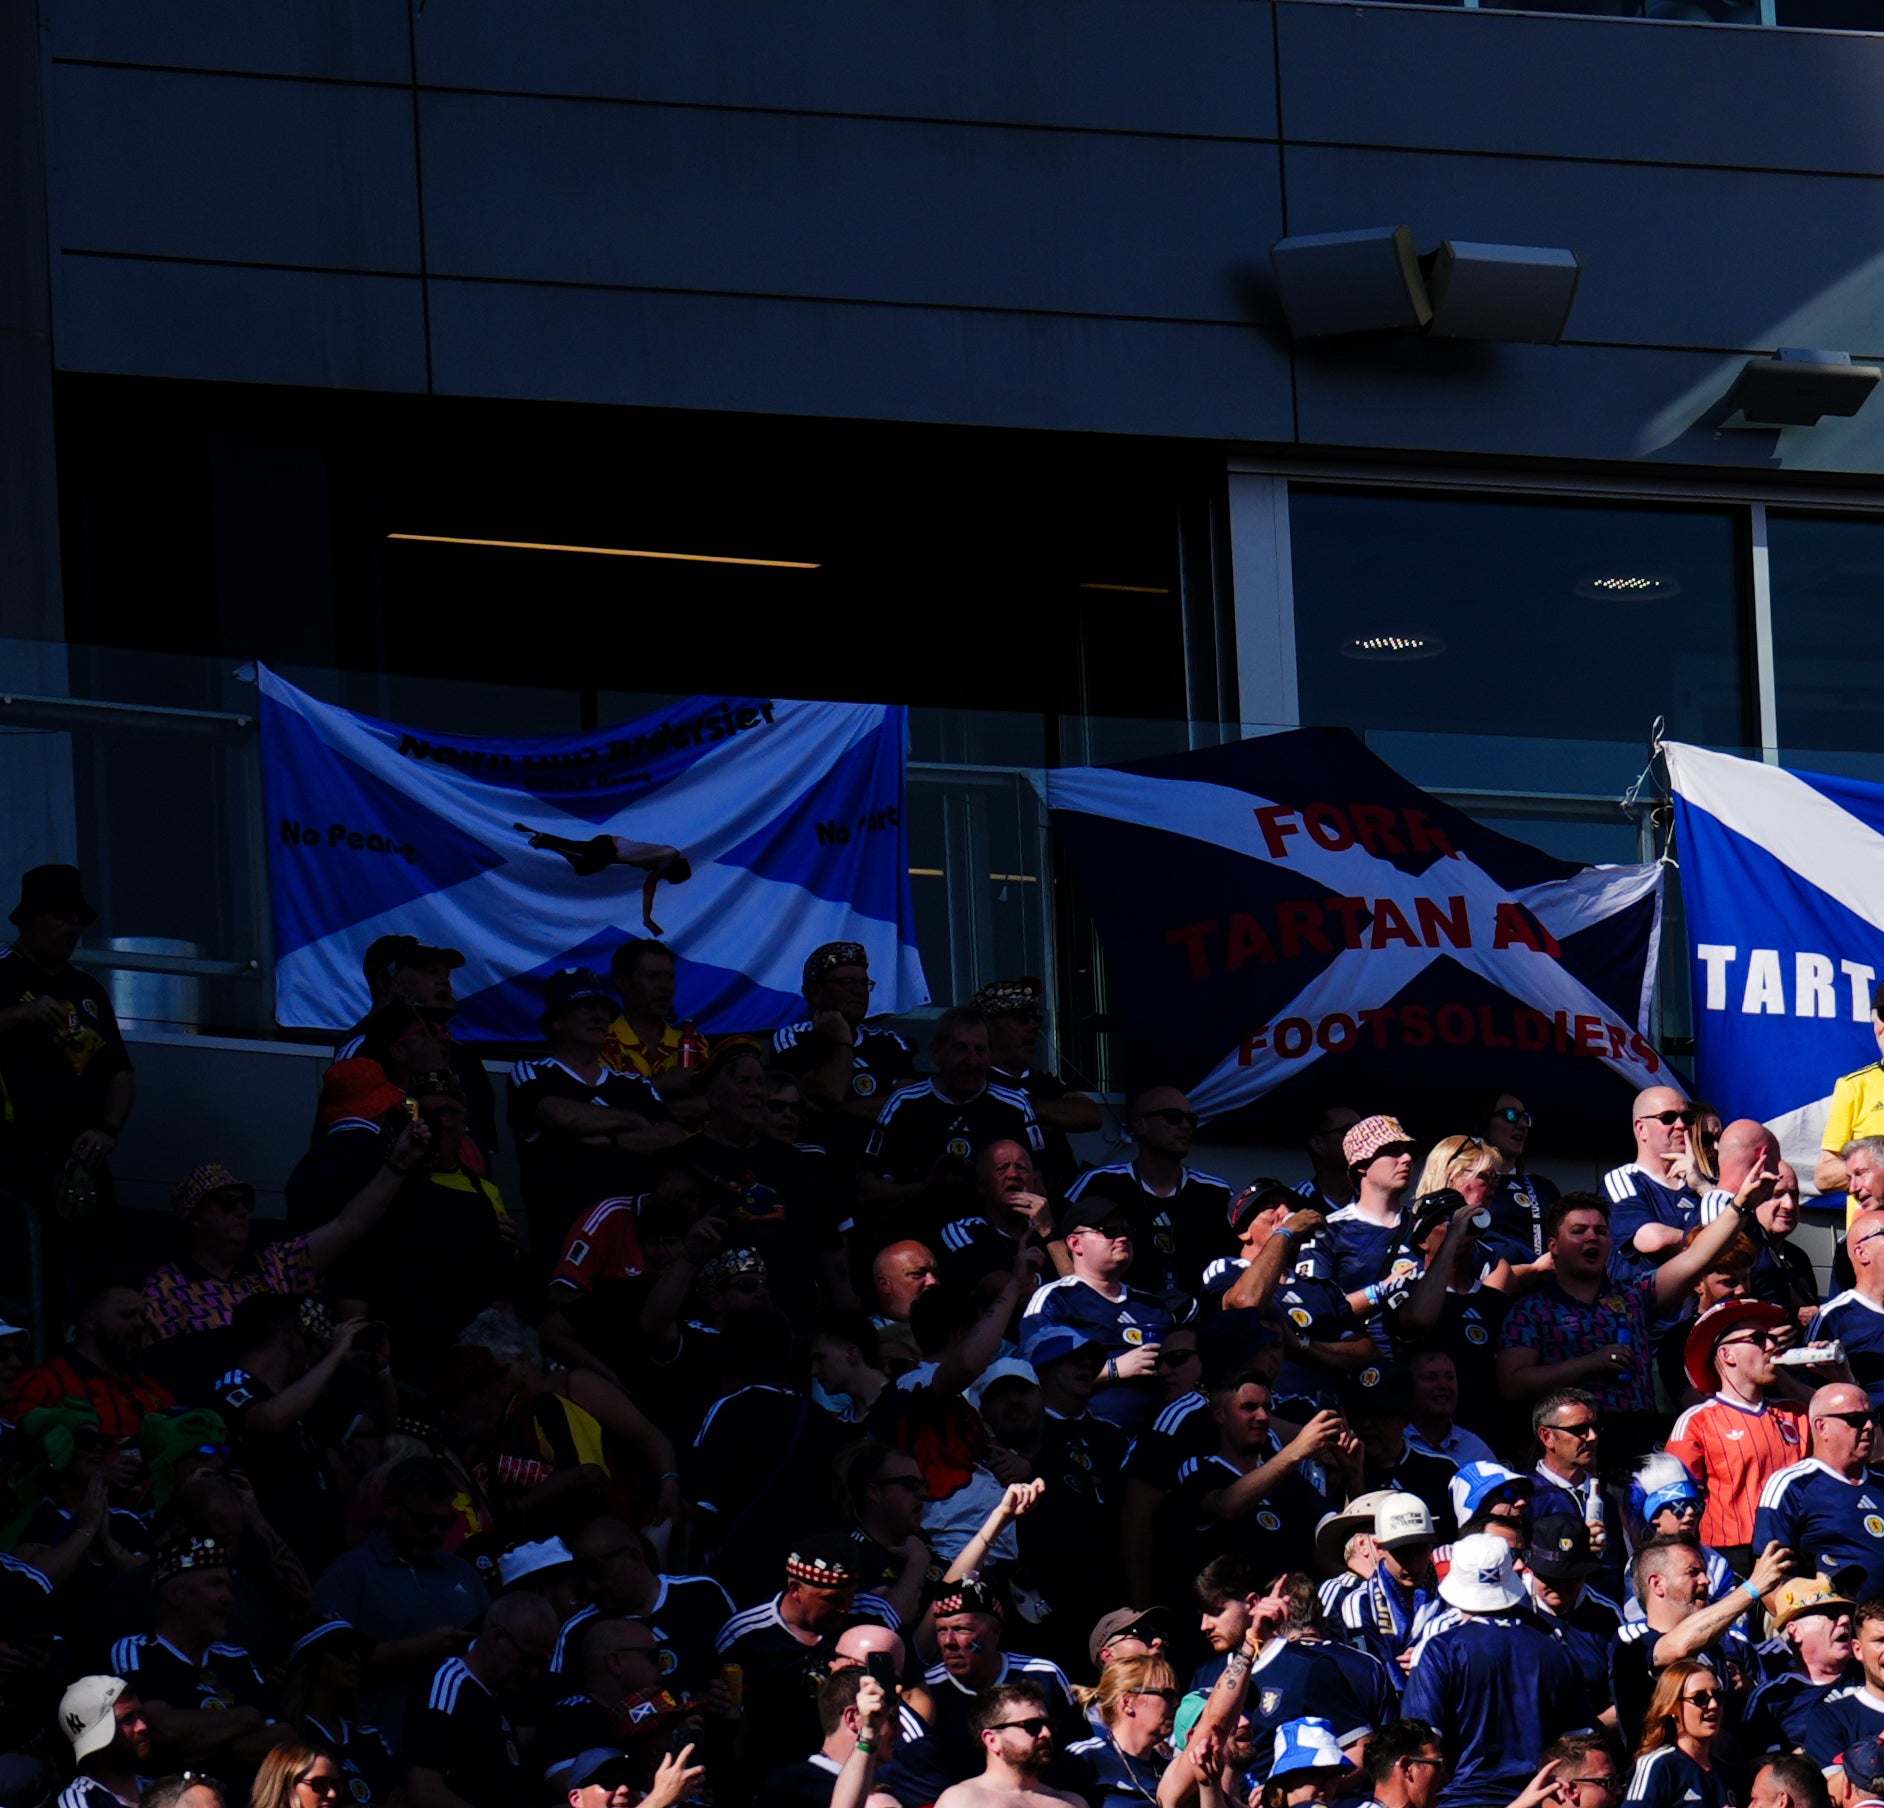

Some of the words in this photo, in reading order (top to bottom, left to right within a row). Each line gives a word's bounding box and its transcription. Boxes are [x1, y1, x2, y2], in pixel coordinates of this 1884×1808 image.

[281, 820, 319, 846] No
[816, 820, 850, 845] No
[1166, 895, 1471, 982] TARTAN
